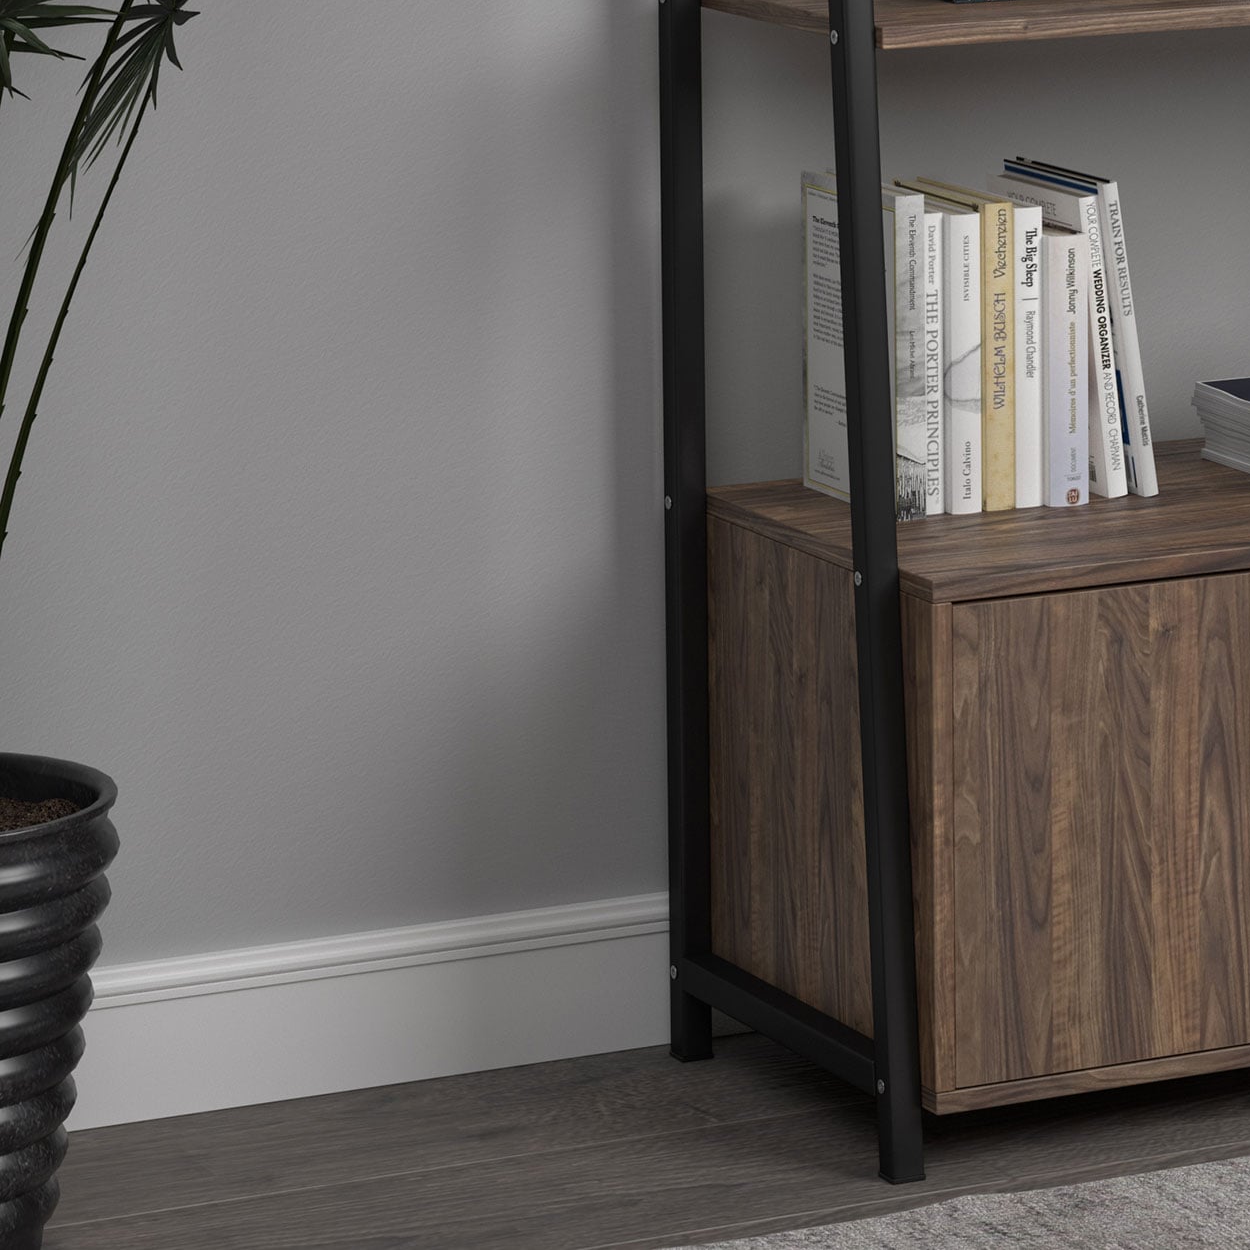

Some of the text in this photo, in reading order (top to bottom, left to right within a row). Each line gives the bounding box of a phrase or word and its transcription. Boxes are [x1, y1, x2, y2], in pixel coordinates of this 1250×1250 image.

[908, 214, 917, 311] The Eleventh Commandment
[1021, 228, 1038, 288] The Big Sleep
[1066, 248, 1078, 314] Jonny Wilkinson
[1108, 200, 1133, 317] TRAIN FOR RESULTS
[993, 292, 1007, 342] BUSCH
[1023, 310, 1036, 378] Raymond Chandler
[1086, 201, 1122, 471] YOUR COMPLETE WEDDING ORGANIZER AND RECORD CHAPMAN
[926, 225, 940, 496] David Porter THE PORTER PRINCIPLES
[993, 345, 1006, 410] WILHELM
[1136, 394, 1146, 426] Catherine
[962, 441, 971, 500] Italo Calvino
